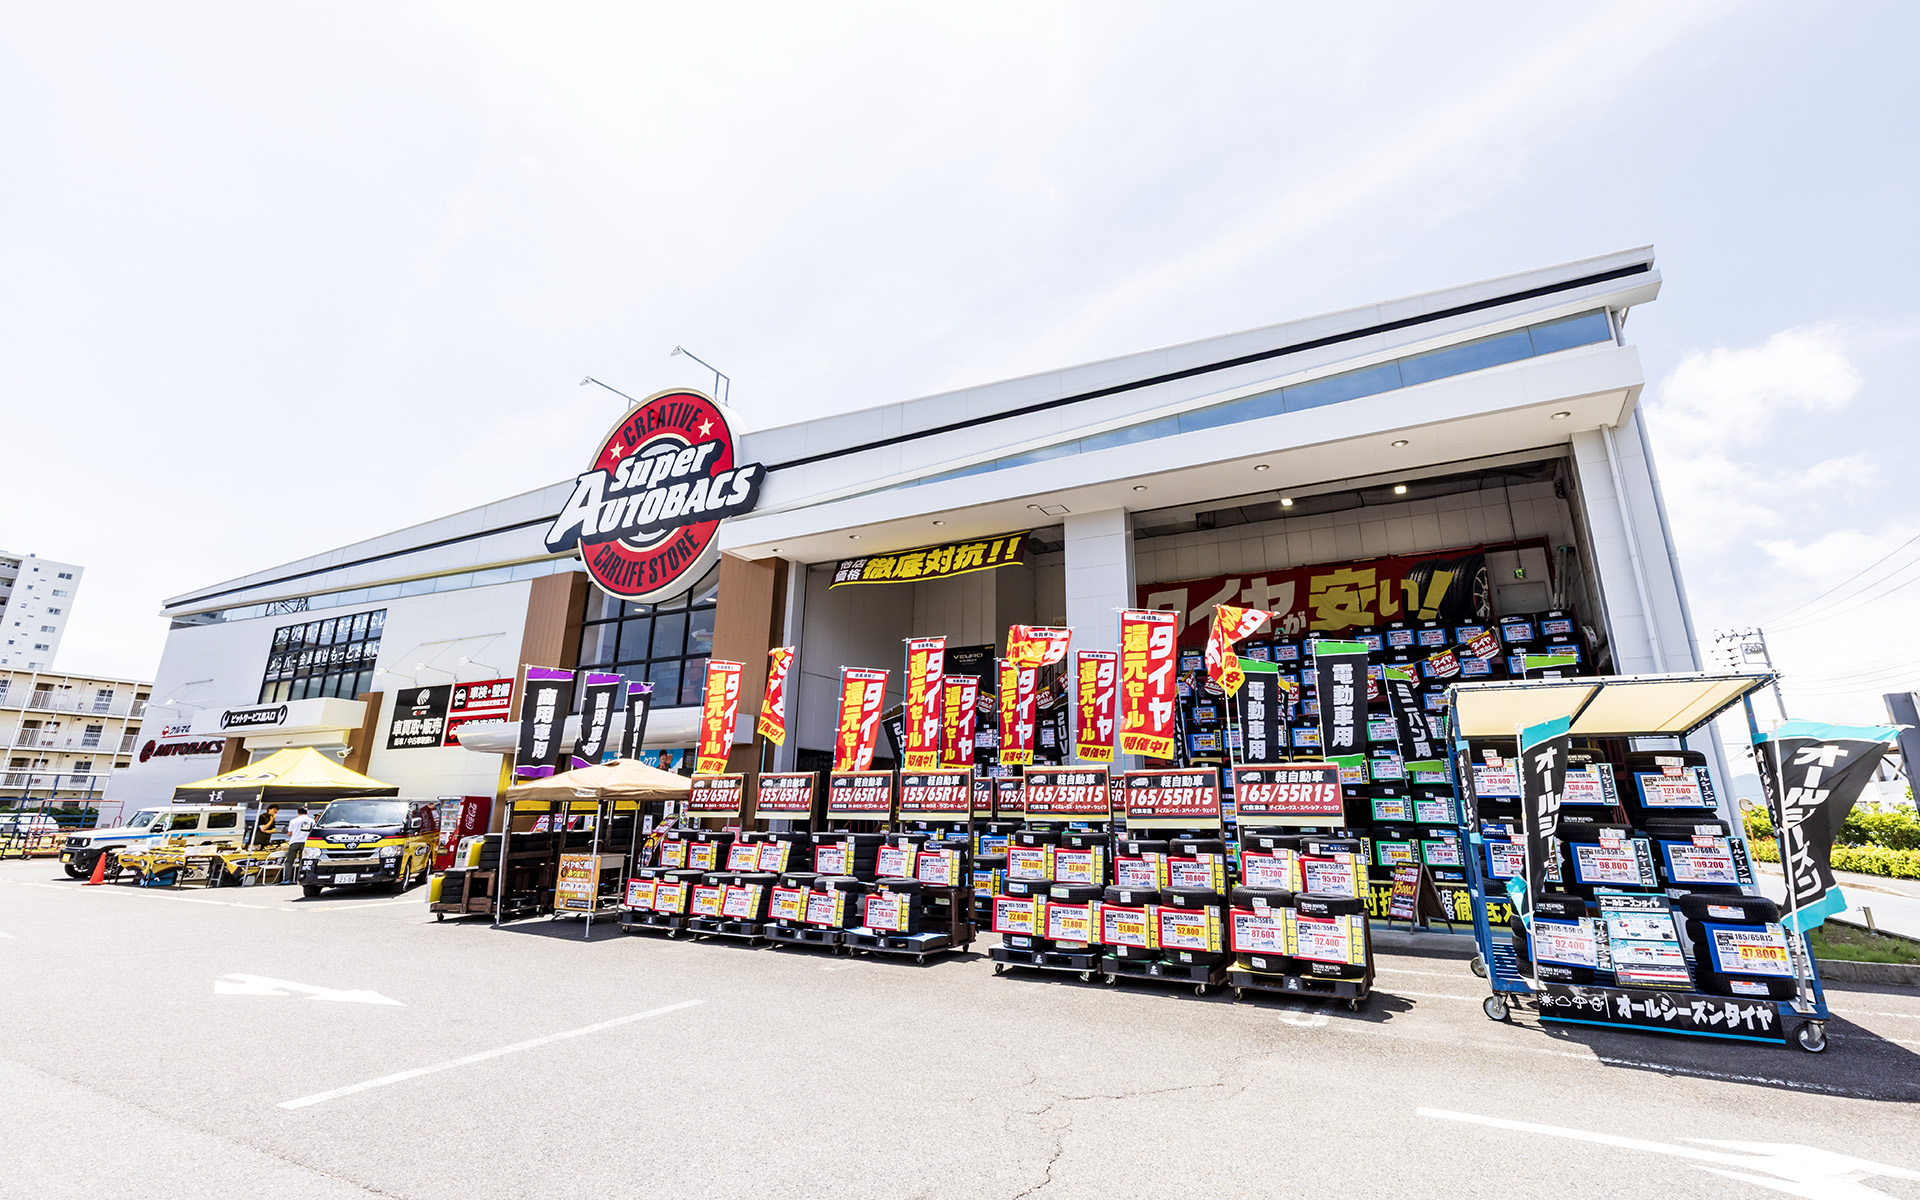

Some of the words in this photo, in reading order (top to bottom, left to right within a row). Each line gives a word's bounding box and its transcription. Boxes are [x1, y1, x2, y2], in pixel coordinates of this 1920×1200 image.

[623, 402, 703, 448] CREATIVE
[609, 442, 717, 492] Super
[546, 465, 758, 546] AUTOBACS
[593, 544, 646, 588] CARLIFE
[649, 529, 701, 584] STORE
[840, 558, 867, 570] 他店
[862, 537, 1022, 580] 徹底対抗!!
[834, 568, 861, 583] 価格
[1123, 624, 1149, 730] 還元セール
[1147, 625, 1174, 732] タイヤ
[908, 650, 927, 748] 還元セール
[923, 650, 944, 748] タイヤ
[1015, 668, 1036, 746] タイヤ
[1080, 661, 1098, 742] 還元セール
[1096, 661, 1115, 743] タイヤ
[1331, 663, 1355, 748] 電動車用
[703, 672, 726, 756] 還元セール
[723, 673, 740, 756] タイヤ
[1000, 670, 1018, 748] 還元セール
[392, 717, 443, 737] 車買取・販売
[841, 681, 866, 771] 還元セール
[854, 683, 884, 772] タイヤ
[943, 685, 962, 762] 還元セール
[958, 686, 977, 762] タイヤ
[1247, 681, 1267, 760] 電動車用
[1396, 683, 1433, 758] ミニバン用
[152, 740, 226, 757] AUTOBACS
[1079, 746, 1111, 760] 開催中!
[1124, 736, 1170, 755] 開催中!
[854, 777, 884, 787] 軽自動車
[927, 775, 961, 786] 軽自動車
[1056, 773, 1096, 786] 軽自動車
[1160, 775, 1204, 788] 軽自動車
[1274, 770, 1325, 783] 軽自動車
[691, 788, 740, 802] 155/65R14
[759, 788, 810, 802] 155/65R14
[831, 787, 889, 802] 155/65R14
[902, 786, 967, 802] 155/65R14
[1028, 786, 1105, 803] 165/55R15
[1129, 787, 1214, 806] 165/55R15
[1239, 784, 1336, 803] 165/55R15
[1662, 787, 1692, 795] 127,600
[1785, 745, 1849, 900] オールシーズン
[1598, 861, 1629, 871] 98,800
[1692, 861, 1725, 869] 109,200
[1118, 924, 1140, 933] 51,800
[1176, 927, 1200, 936] 52,800
[1733, 933, 1774, 943] 185/65R15
[1314, 937, 1340, 947] 92,400
[1554, 939, 1586, 951] 92,400
[1741, 948, 1778, 960] 47,800
[1615, 993, 1774, 1031] オールシーズンタイヤ
